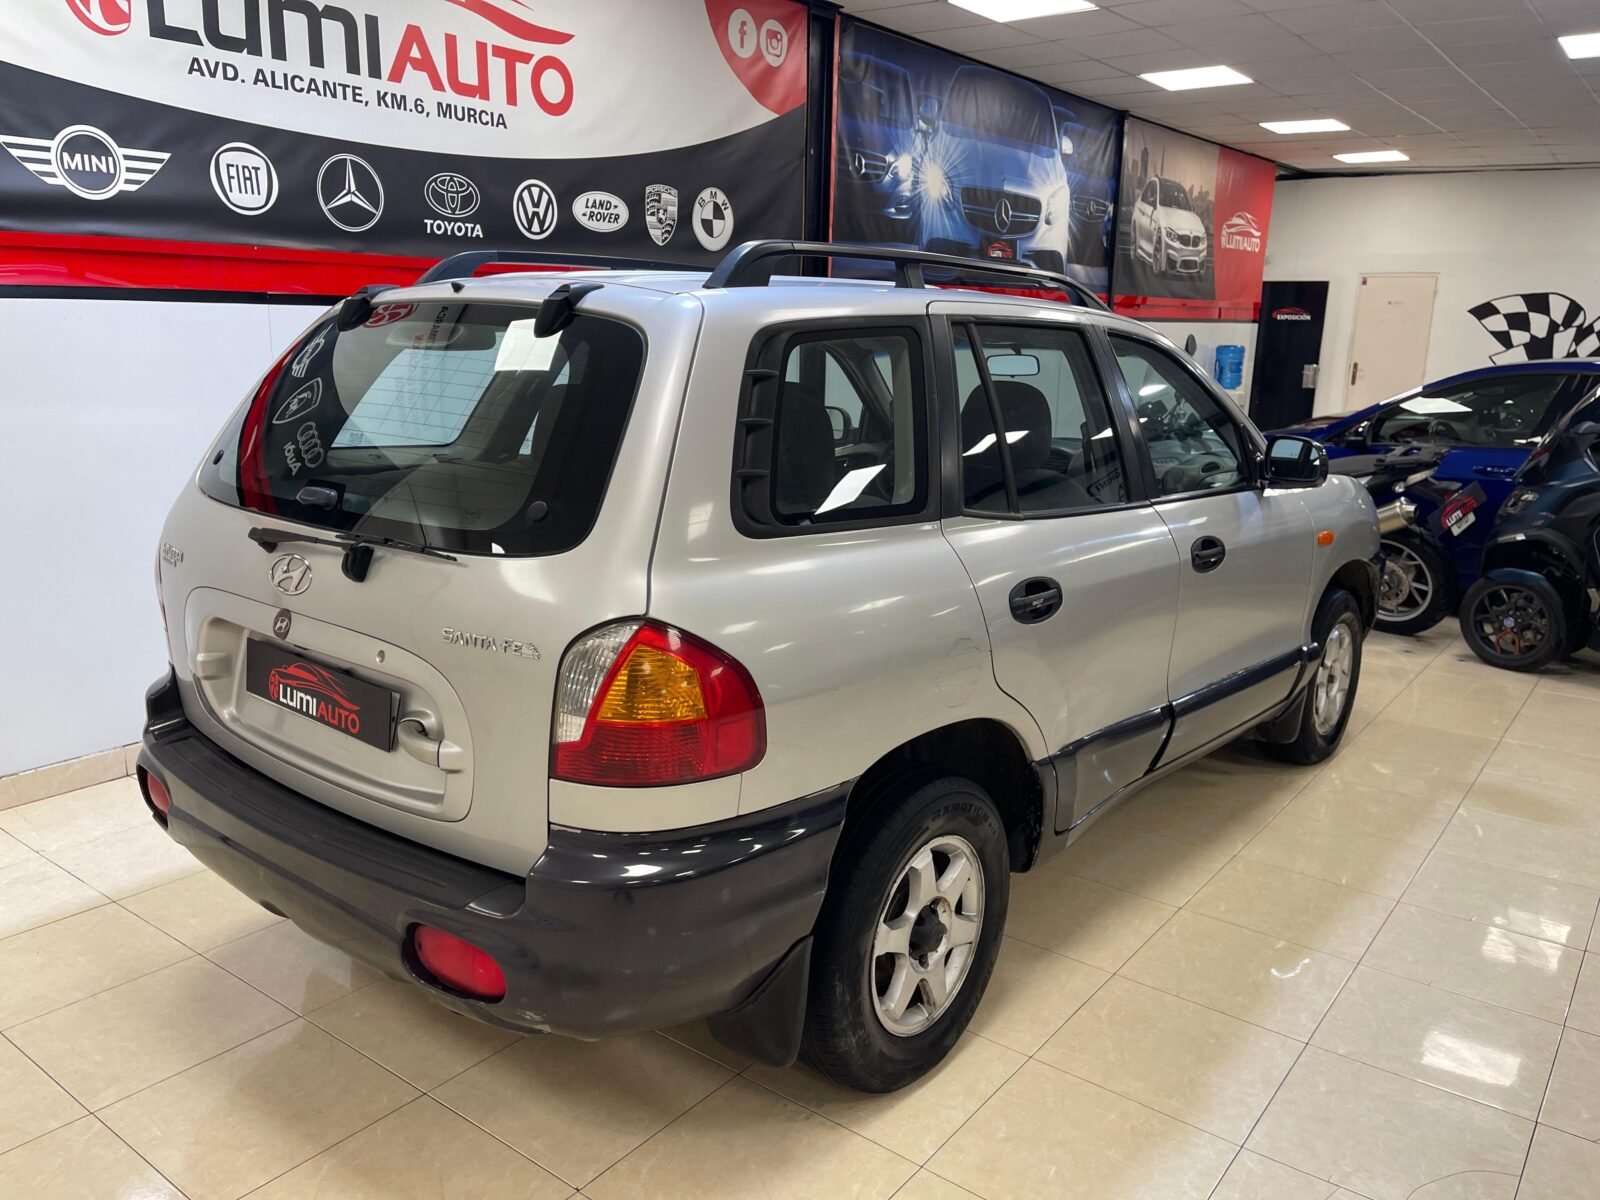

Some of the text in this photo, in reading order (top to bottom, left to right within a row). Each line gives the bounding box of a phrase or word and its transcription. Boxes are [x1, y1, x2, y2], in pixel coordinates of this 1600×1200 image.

[187, 56, 508, 130] AVD. ALICANTE, KM.6, MURCIA
[61, 151, 115, 174] MINI
[226, 163, 261, 196] FIAT
[585, 197, 612, 211] LAND
[697, 190, 730, 212] BMW
[423, 219, 484, 238] TOYOTA
[587, 210, 620, 225] ROVER
[442, 628, 523, 656] SANTA FE
